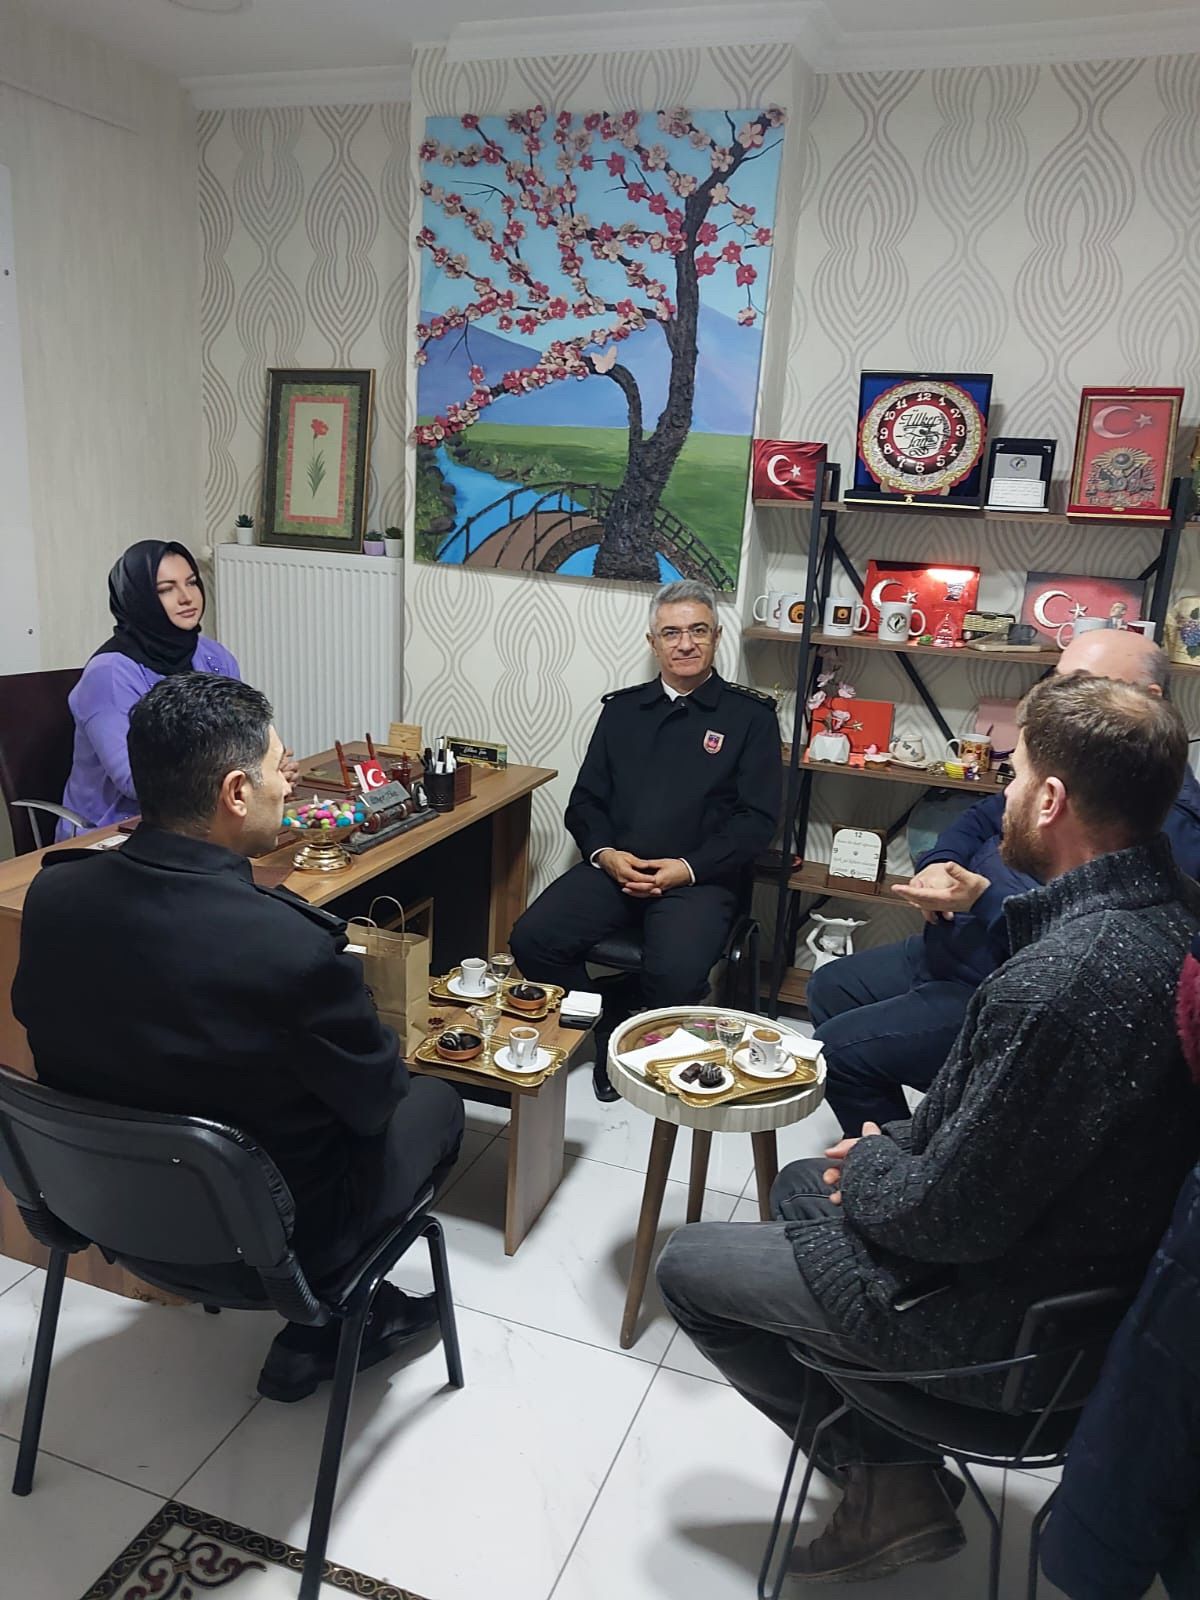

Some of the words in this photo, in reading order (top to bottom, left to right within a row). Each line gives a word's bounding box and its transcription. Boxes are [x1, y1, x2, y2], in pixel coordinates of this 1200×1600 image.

[916, 393, 932, 402] 12
[939, 397, 947, 406] 1
[895, 400, 908, 409] 11
[884, 410, 896, 421] 10
[951, 408, 961, 418] 2
[879, 427, 889, 440] 9
[955, 424, 966, 437] 3
[883, 444, 894, 455] 8
[948, 443, 959, 457] 4
[897, 456, 906, 468] 7
[936, 455, 946, 467] 5
[915, 461, 925, 473] 6
